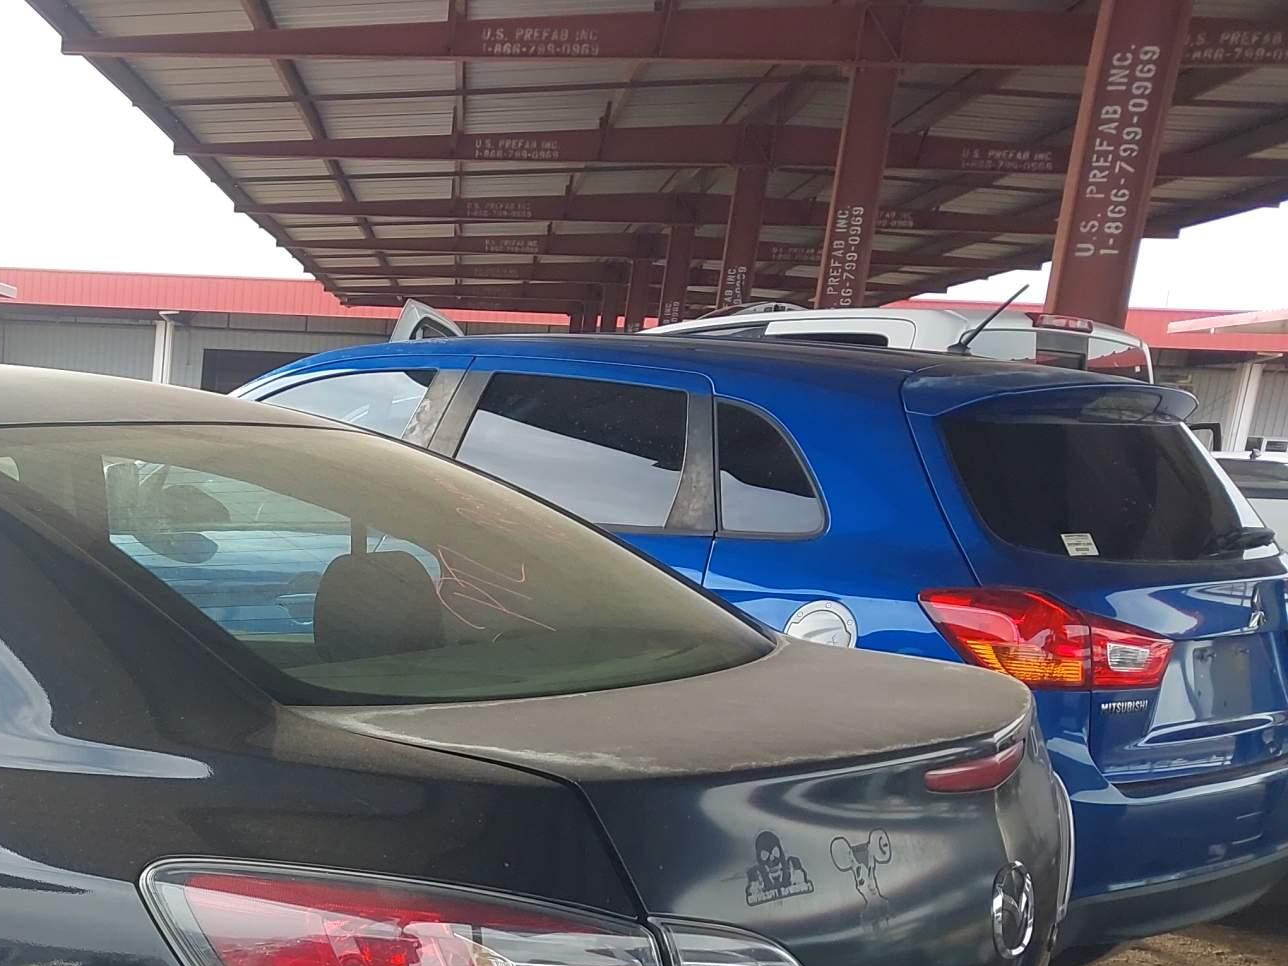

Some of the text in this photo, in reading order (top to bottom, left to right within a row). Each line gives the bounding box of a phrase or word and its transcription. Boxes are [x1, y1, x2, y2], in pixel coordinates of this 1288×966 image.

[1074, 43, 1137, 258] U.S. PREFAB INC.
[1099, 45, 1161, 255] 1-866-799-0969
[826, 240, 845, 295] PREFAB
[1100, 700, 1149, 715] MITSUBISHI
